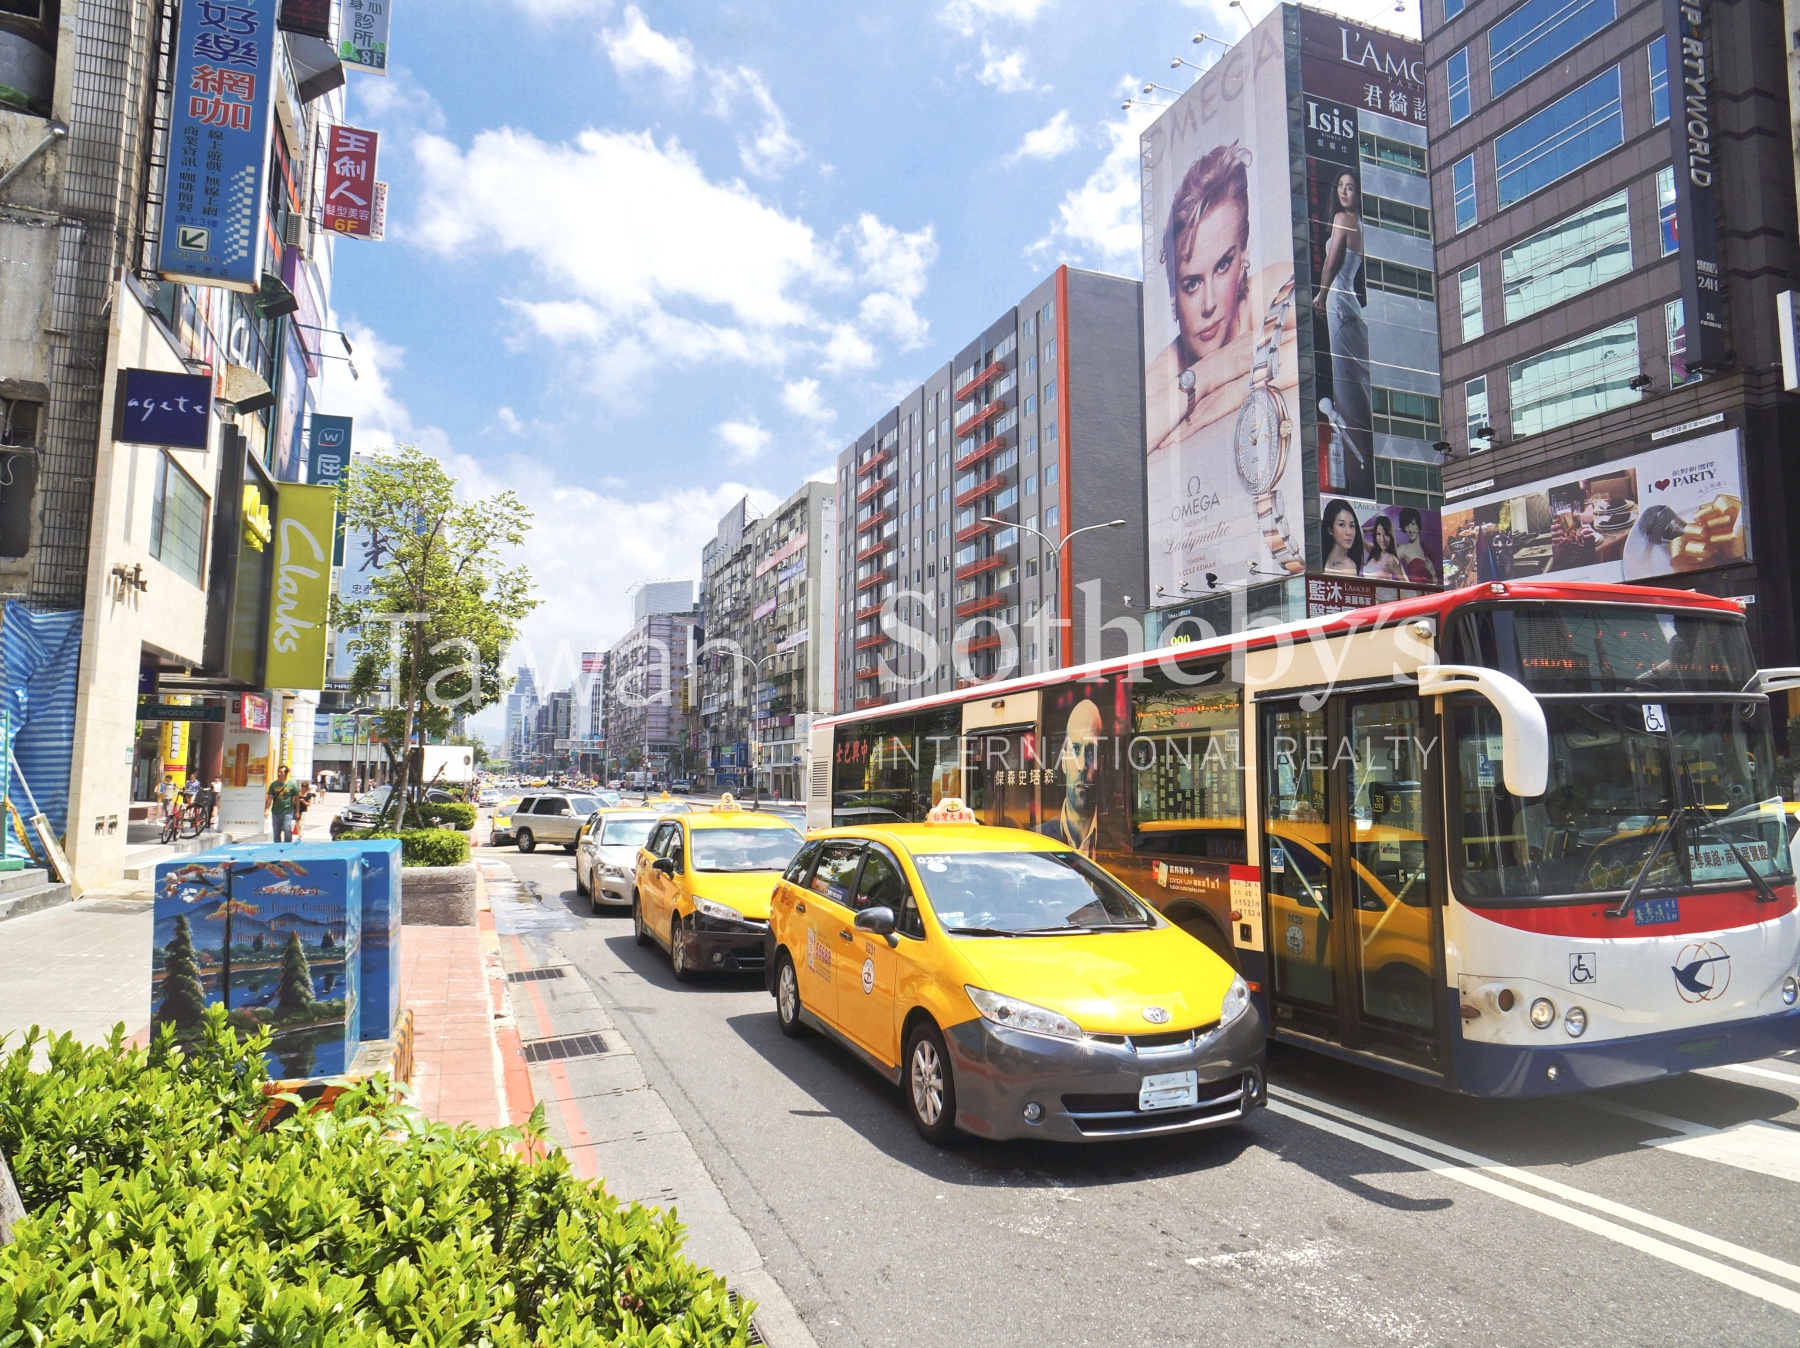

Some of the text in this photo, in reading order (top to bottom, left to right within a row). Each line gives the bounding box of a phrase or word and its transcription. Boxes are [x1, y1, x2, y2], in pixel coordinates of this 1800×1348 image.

[362, 50, 383, 67] 8F
[1306, 100, 1354, 139] Isis
[334, 218, 359, 233] 6F
[1697, 276, 1718, 291] 24H
[127, 396, 207, 422] agete
[1673, 468, 1717, 488] PARTY
[1171, 491, 1221, 522] OMEGA
[1163, 520, 1231, 556] Ladymatic
[273, 518, 324, 653] Clarks
[158, 708, 205, 718] watsons
[995, 768, 1054, 786] 傑森史塔森
[865, 941, 876, 956] 0231
